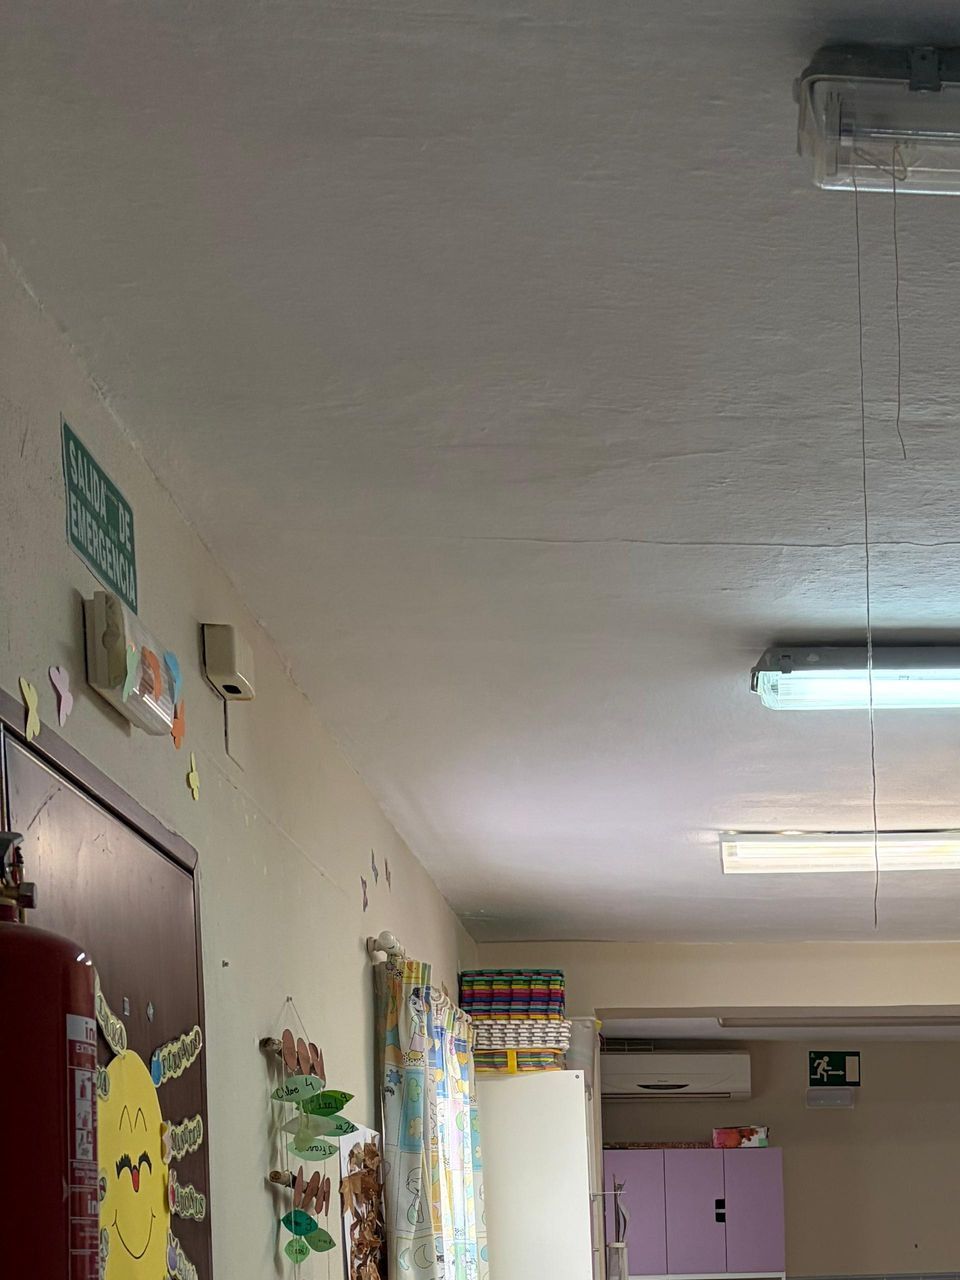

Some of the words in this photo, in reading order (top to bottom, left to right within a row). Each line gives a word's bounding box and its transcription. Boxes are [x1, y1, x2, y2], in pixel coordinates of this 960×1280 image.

[69, 440, 107, 523] SALIDA
[118, 500, 132, 551] DE
[71, 493, 137, 606] EMERGENCIA
[305, 1078, 315, 1091] 4
